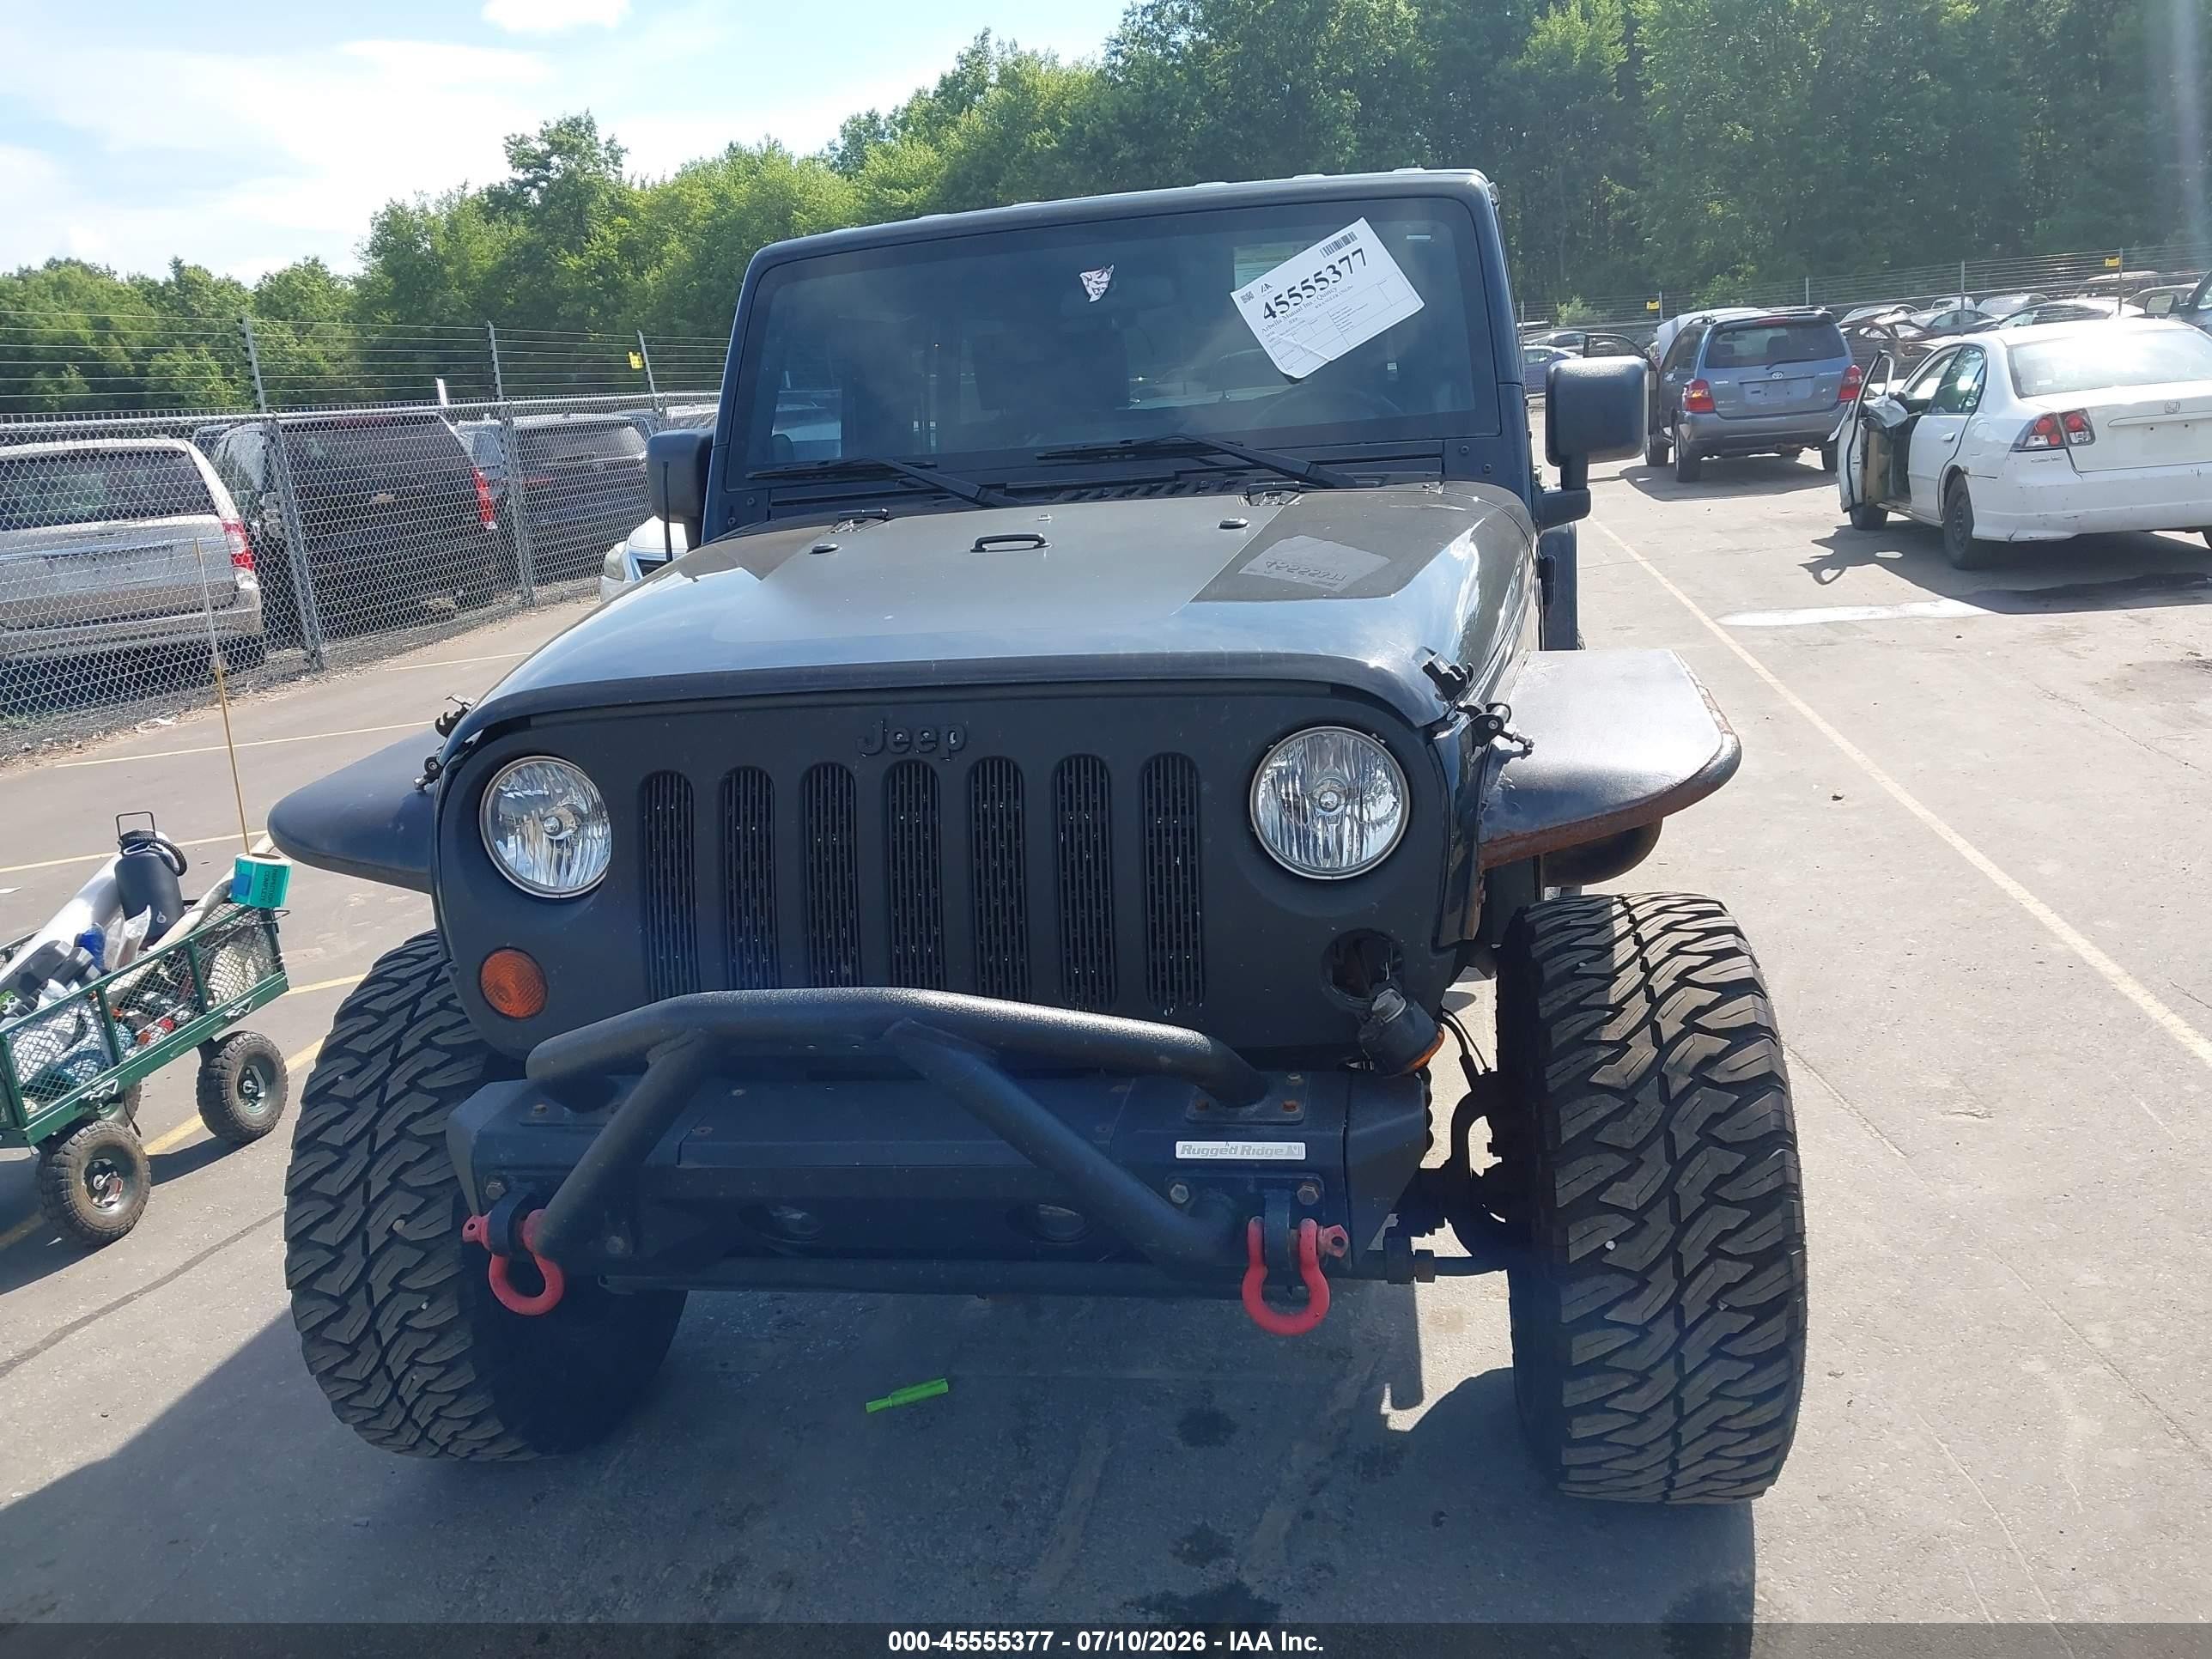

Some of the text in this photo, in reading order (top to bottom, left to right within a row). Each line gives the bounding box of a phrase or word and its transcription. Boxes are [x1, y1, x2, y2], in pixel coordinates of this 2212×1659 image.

[1263, 248, 1367, 321] 45555377
[1282, 307, 1304, 321] Mutual
[1316, 288, 1338, 301] Quincy
[857, 718, 966, 761] Jeep
[1180, 1144, 1285, 1158] Rugged Ridge
